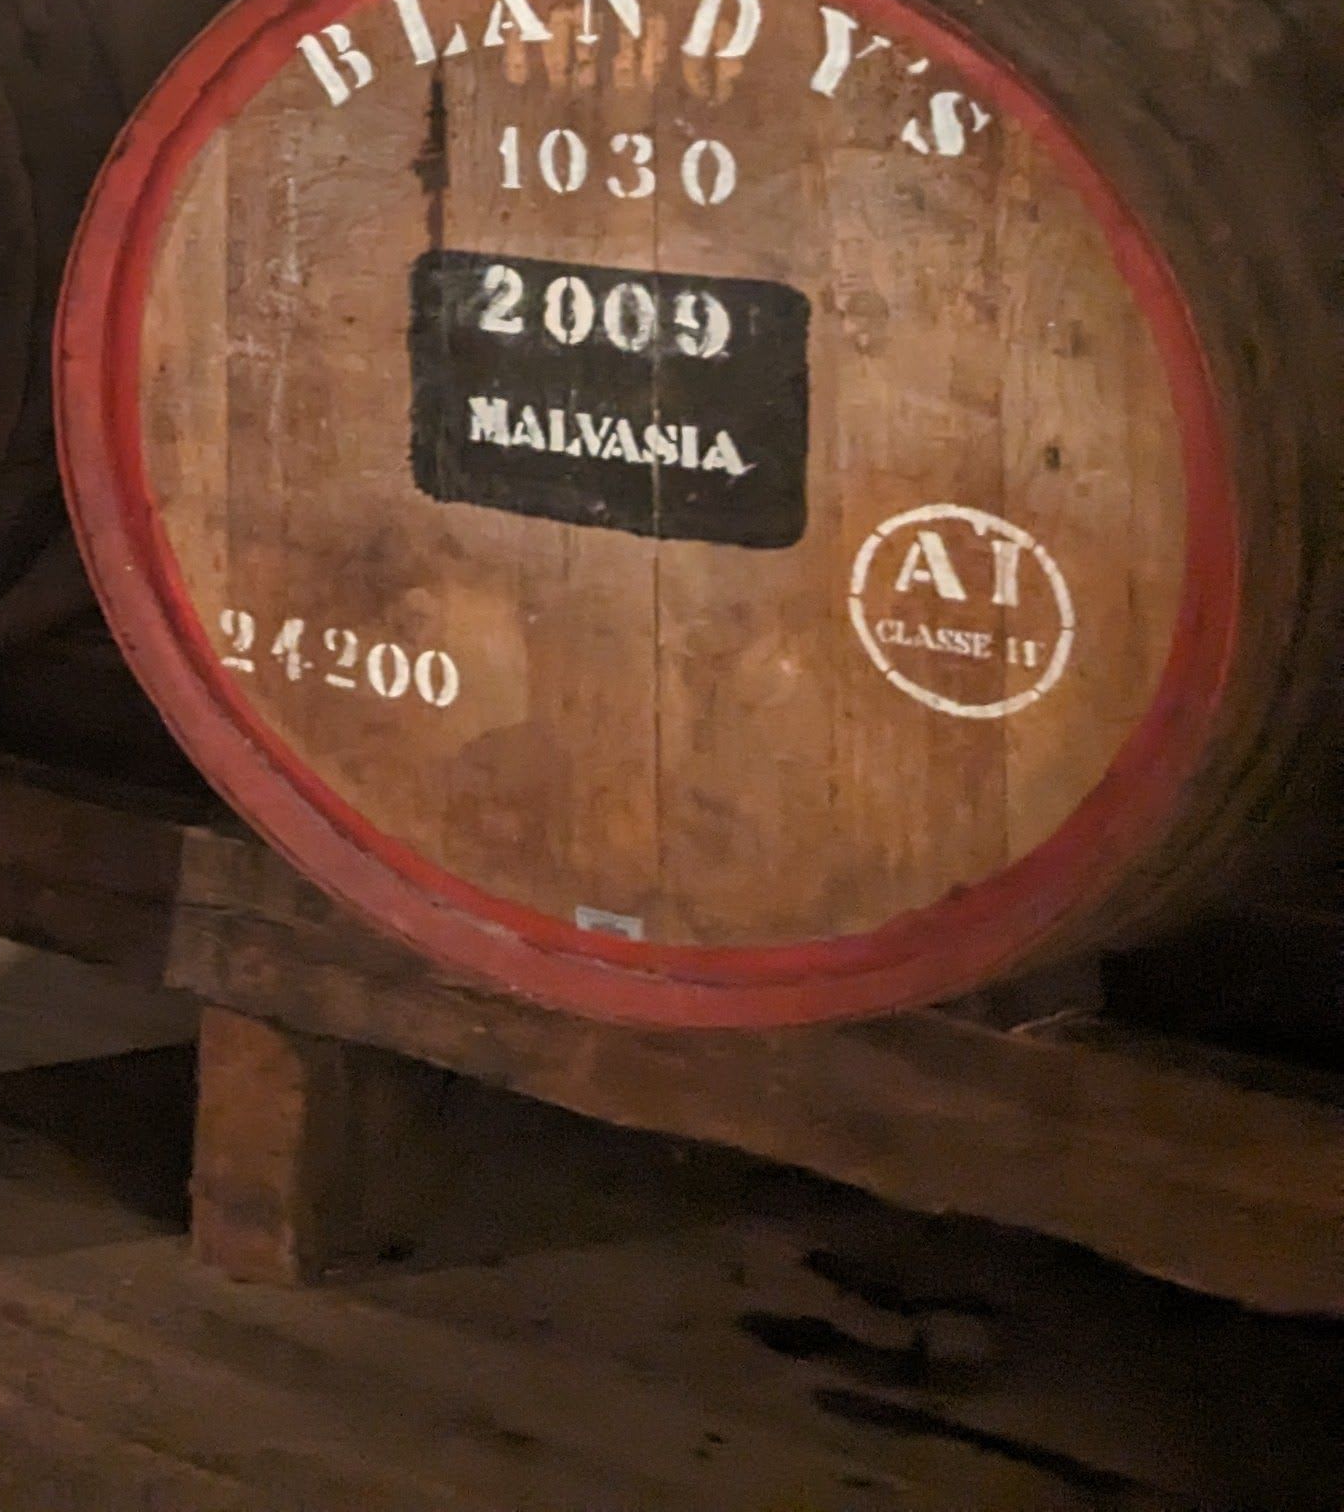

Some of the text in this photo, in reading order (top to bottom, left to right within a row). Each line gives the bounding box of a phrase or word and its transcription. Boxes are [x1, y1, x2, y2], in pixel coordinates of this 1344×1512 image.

[497, 126, 737, 207] 1030
[479, 264, 732, 359] 2009
[467, 395, 752, 477] MALVASIA
[218, 608, 460, 707] 24200
[874, 619, 994, 660] CLASSE
